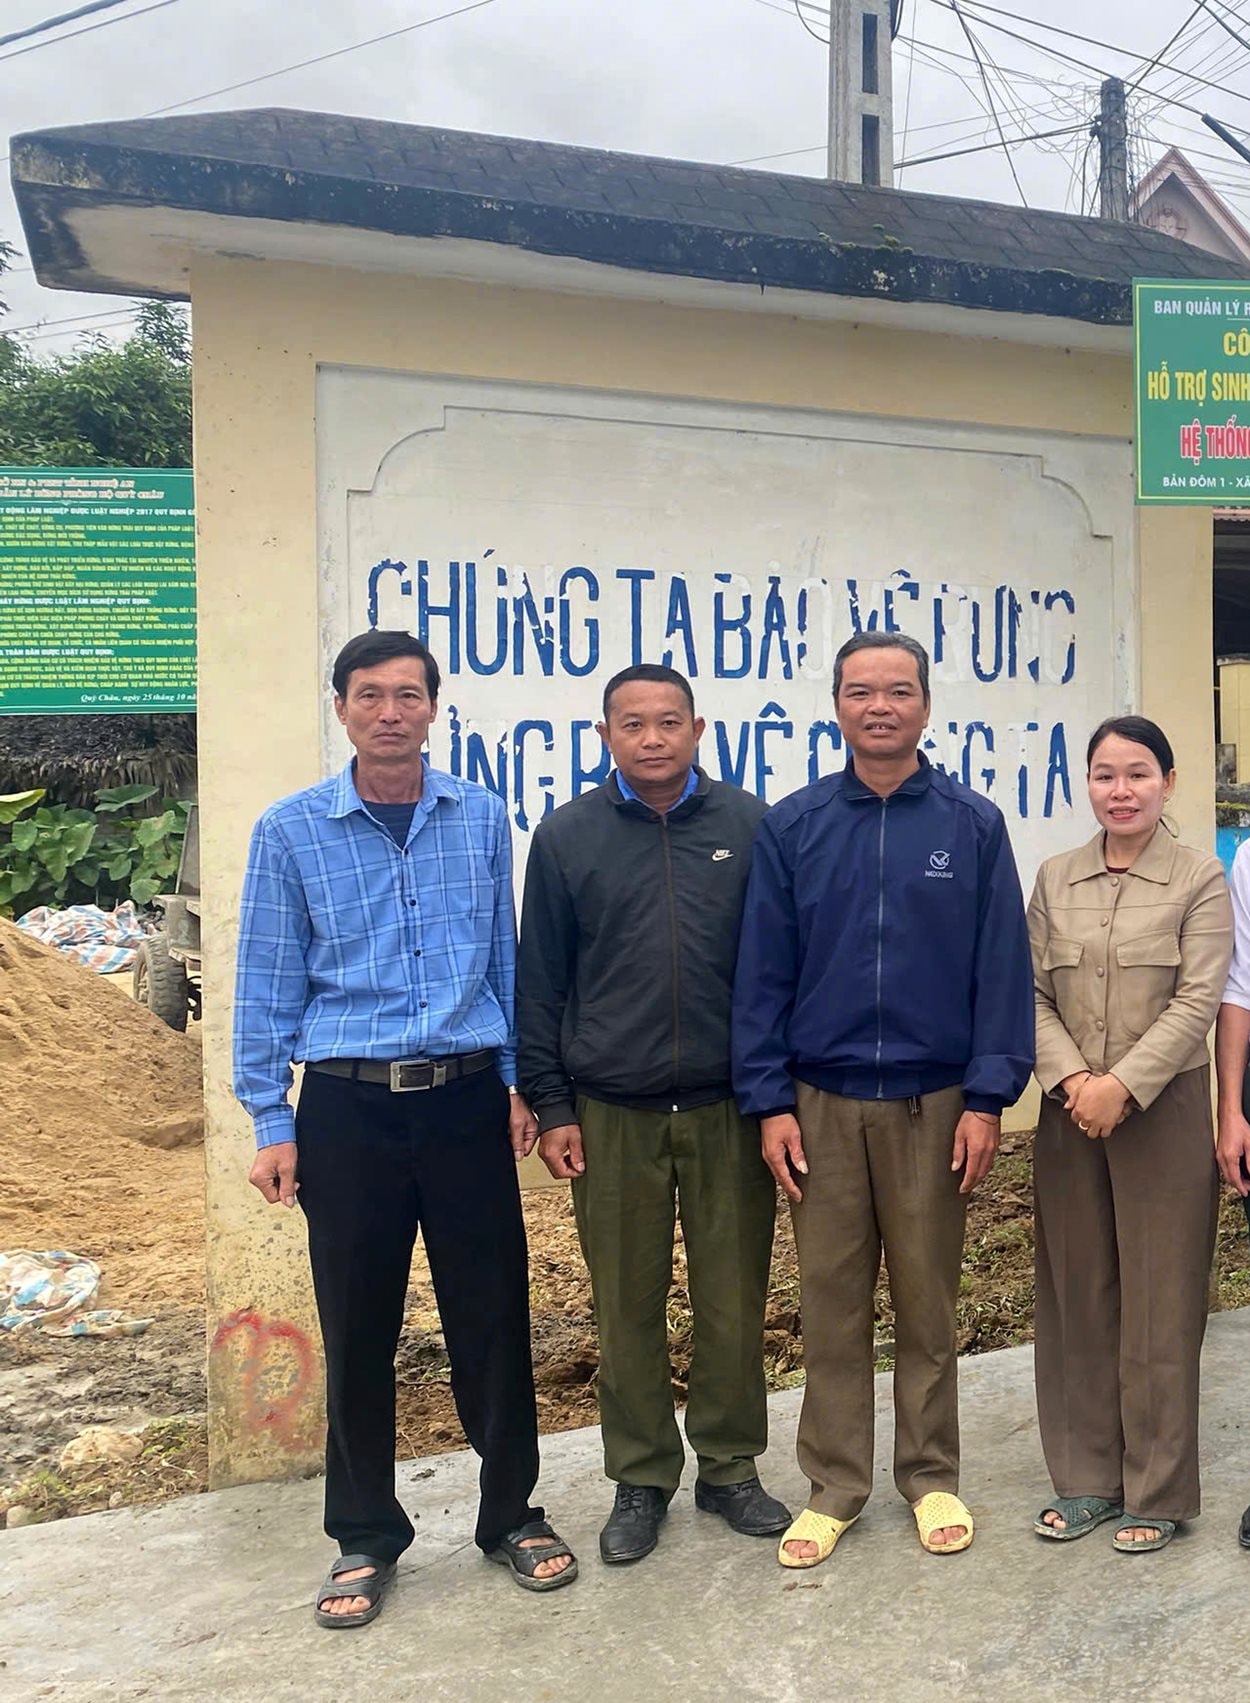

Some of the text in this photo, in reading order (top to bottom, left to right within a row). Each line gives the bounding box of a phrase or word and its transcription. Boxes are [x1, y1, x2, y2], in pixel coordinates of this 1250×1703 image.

[1154, 300, 1181, 314] BAN
[1185, 296, 1221, 316] QUẢN
[1225, 299, 1240, 315] LÝ
[1148, 361, 1170, 400] HỖ
[1175, 370, 1207, 407] TRỢ
[1212, 372, 1250, 401] SINH
[1180, 418, 1202, 466] HỆ
[1162, 473, 1186, 488] BẢN
[1219, 477, 1225, 488] 1
